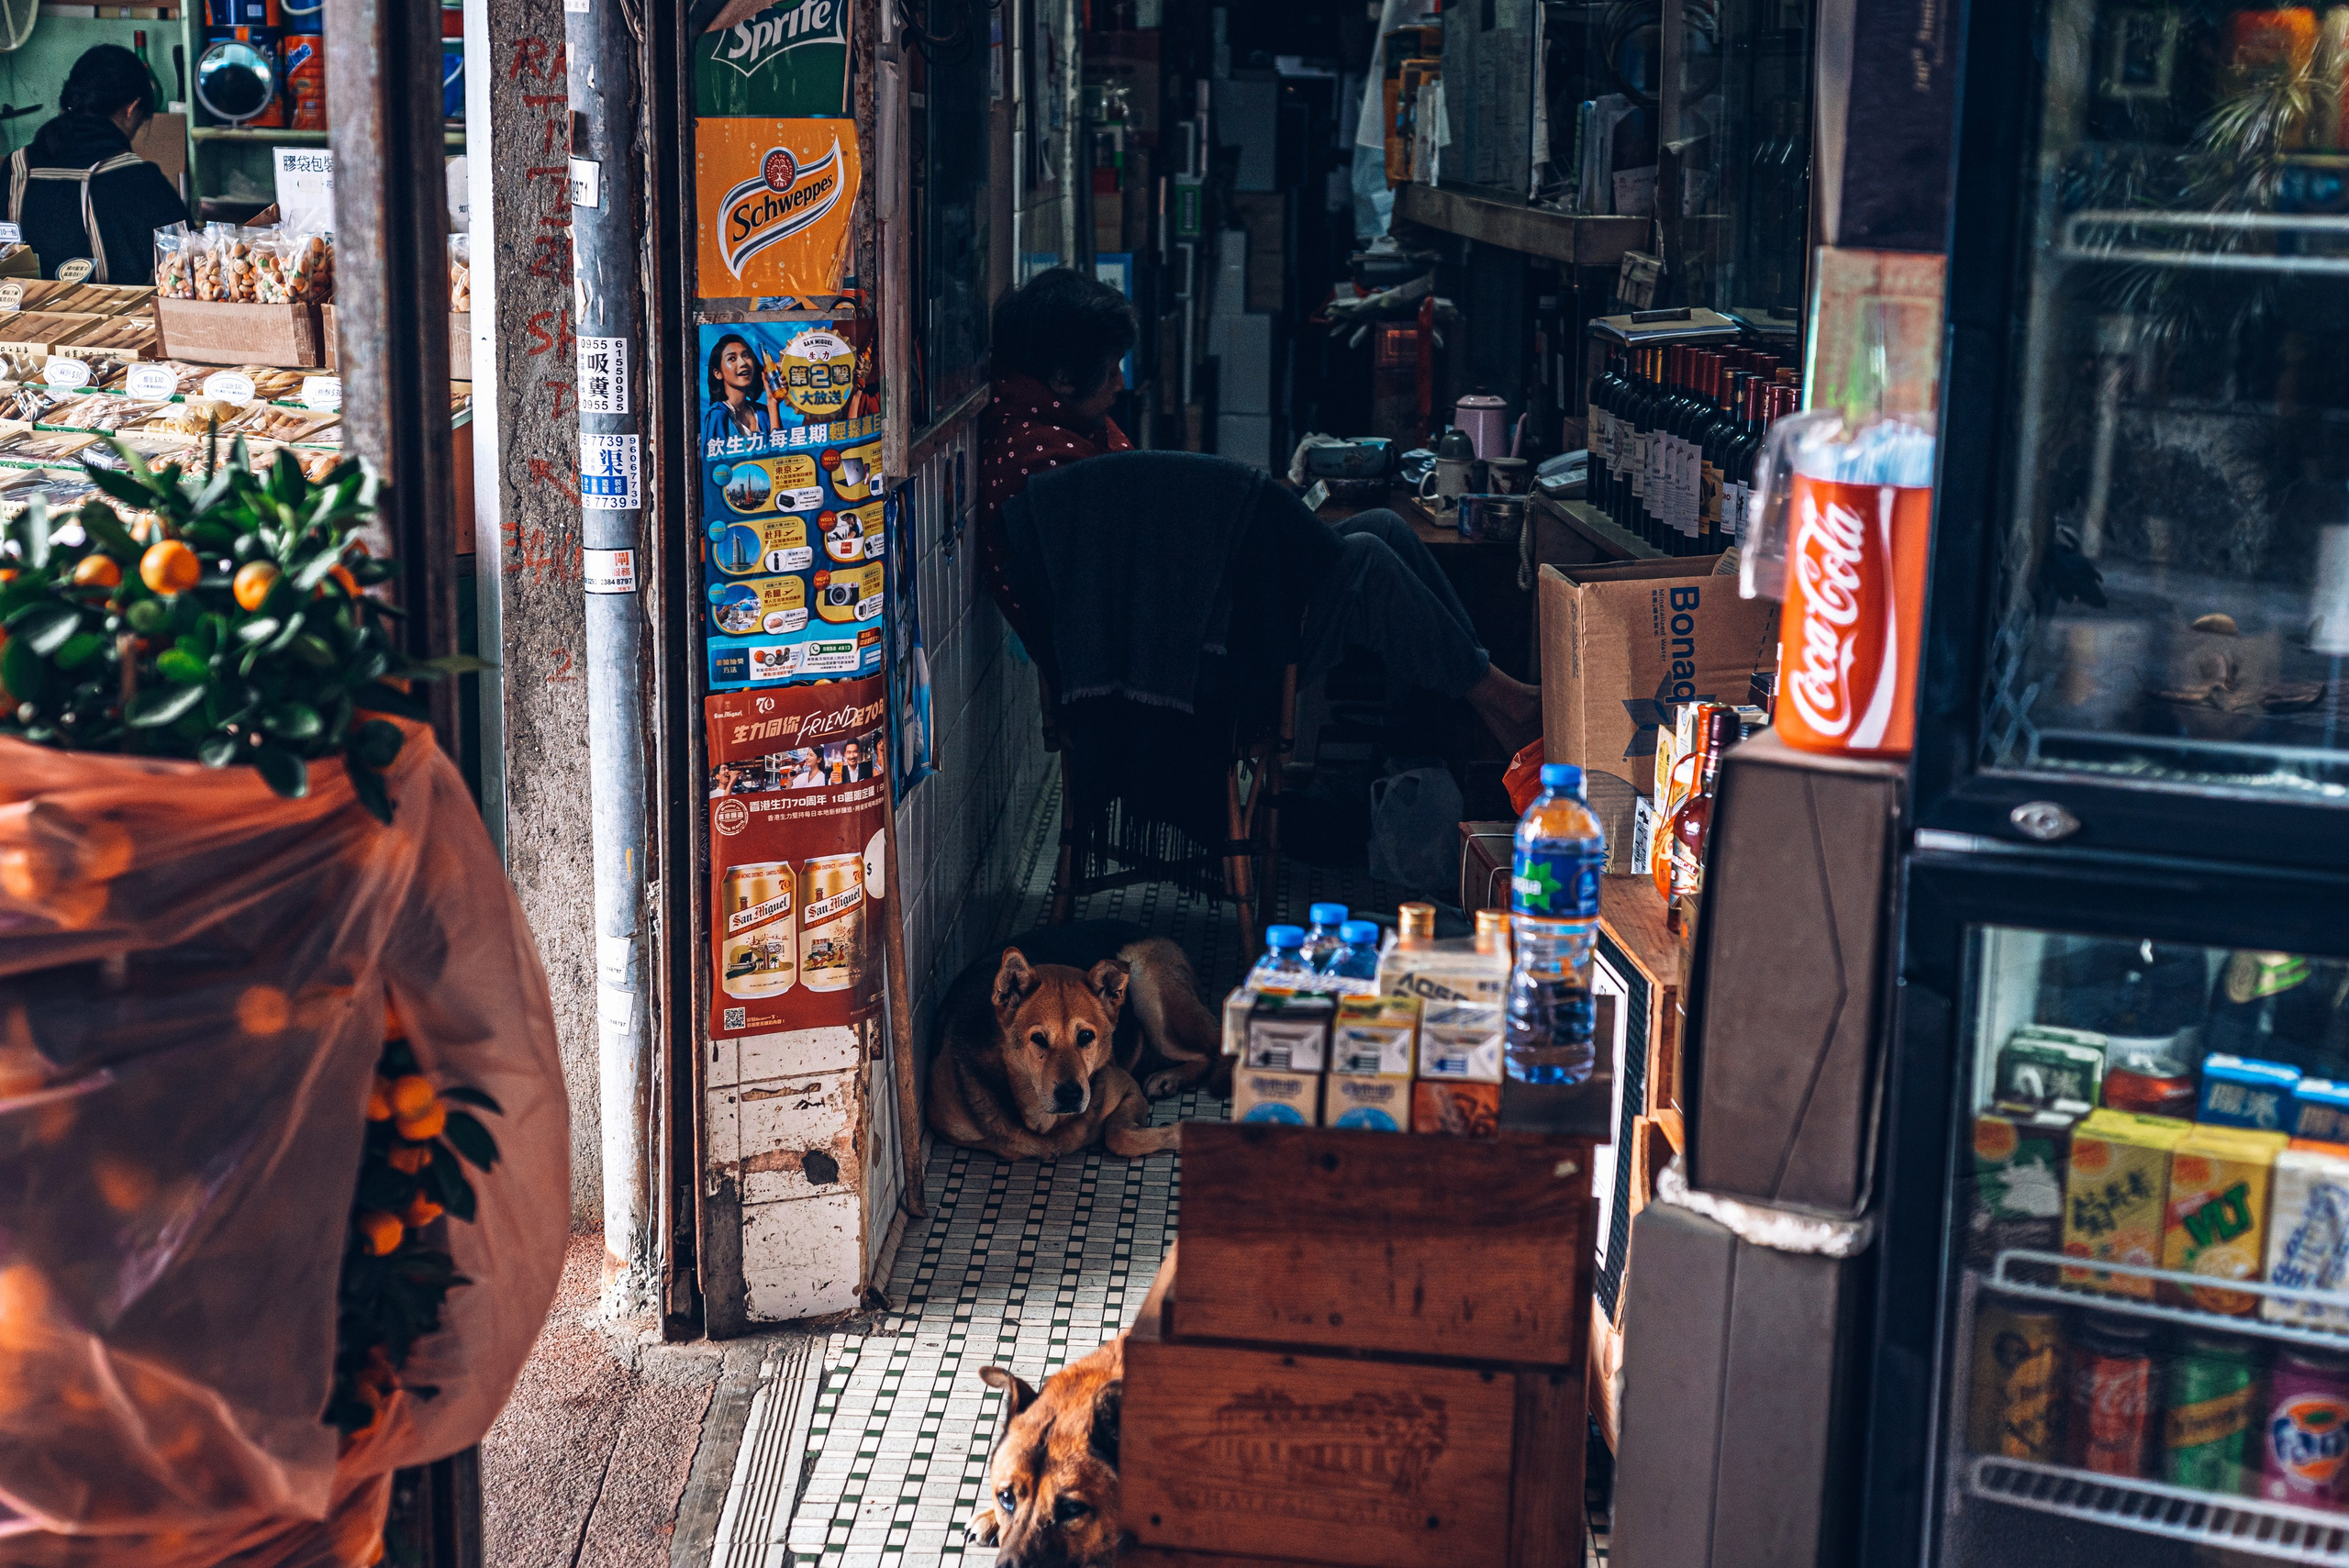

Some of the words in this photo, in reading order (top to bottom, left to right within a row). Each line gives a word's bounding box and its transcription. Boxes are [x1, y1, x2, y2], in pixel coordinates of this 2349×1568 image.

[728, 0, 831, 62] Sprite
[733, 173, 834, 242] Schweppes
[815, 339, 833, 347] MIGUEL
[808, 350, 830, 361] 生力
[591, 436, 624, 447] 7739
[775, 466, 792, 474] 東京
[595, 496, 627, 508] 7739
[616, 577, 633, 585] 8797
[1788, 489, 1866, 738] Coca-Cola
[755, 696, 775, 714] 70
[713, 711, 724, 719] San
[724, 709, 742, 719] Miguel
[731, 715, 801, 744] 生力同你
[795, 704, 859, 746] FRIEND
[852, 870, 862, 882] 70
[866, 862, 872, 876] $
[778, 879, 791, 891] 70
[808, 904, 829, 918] San
[829, 887, 861, 912] Miguel
[732, 913, 752, 928] San
[753, 895, 788, 920] Miguel
[813, 917, 828, 927] YEARS
[834, 908, 849, 919] HONG
[737, 925, 752, 934] YEARS
[758, 917, 774, 927] HONG
